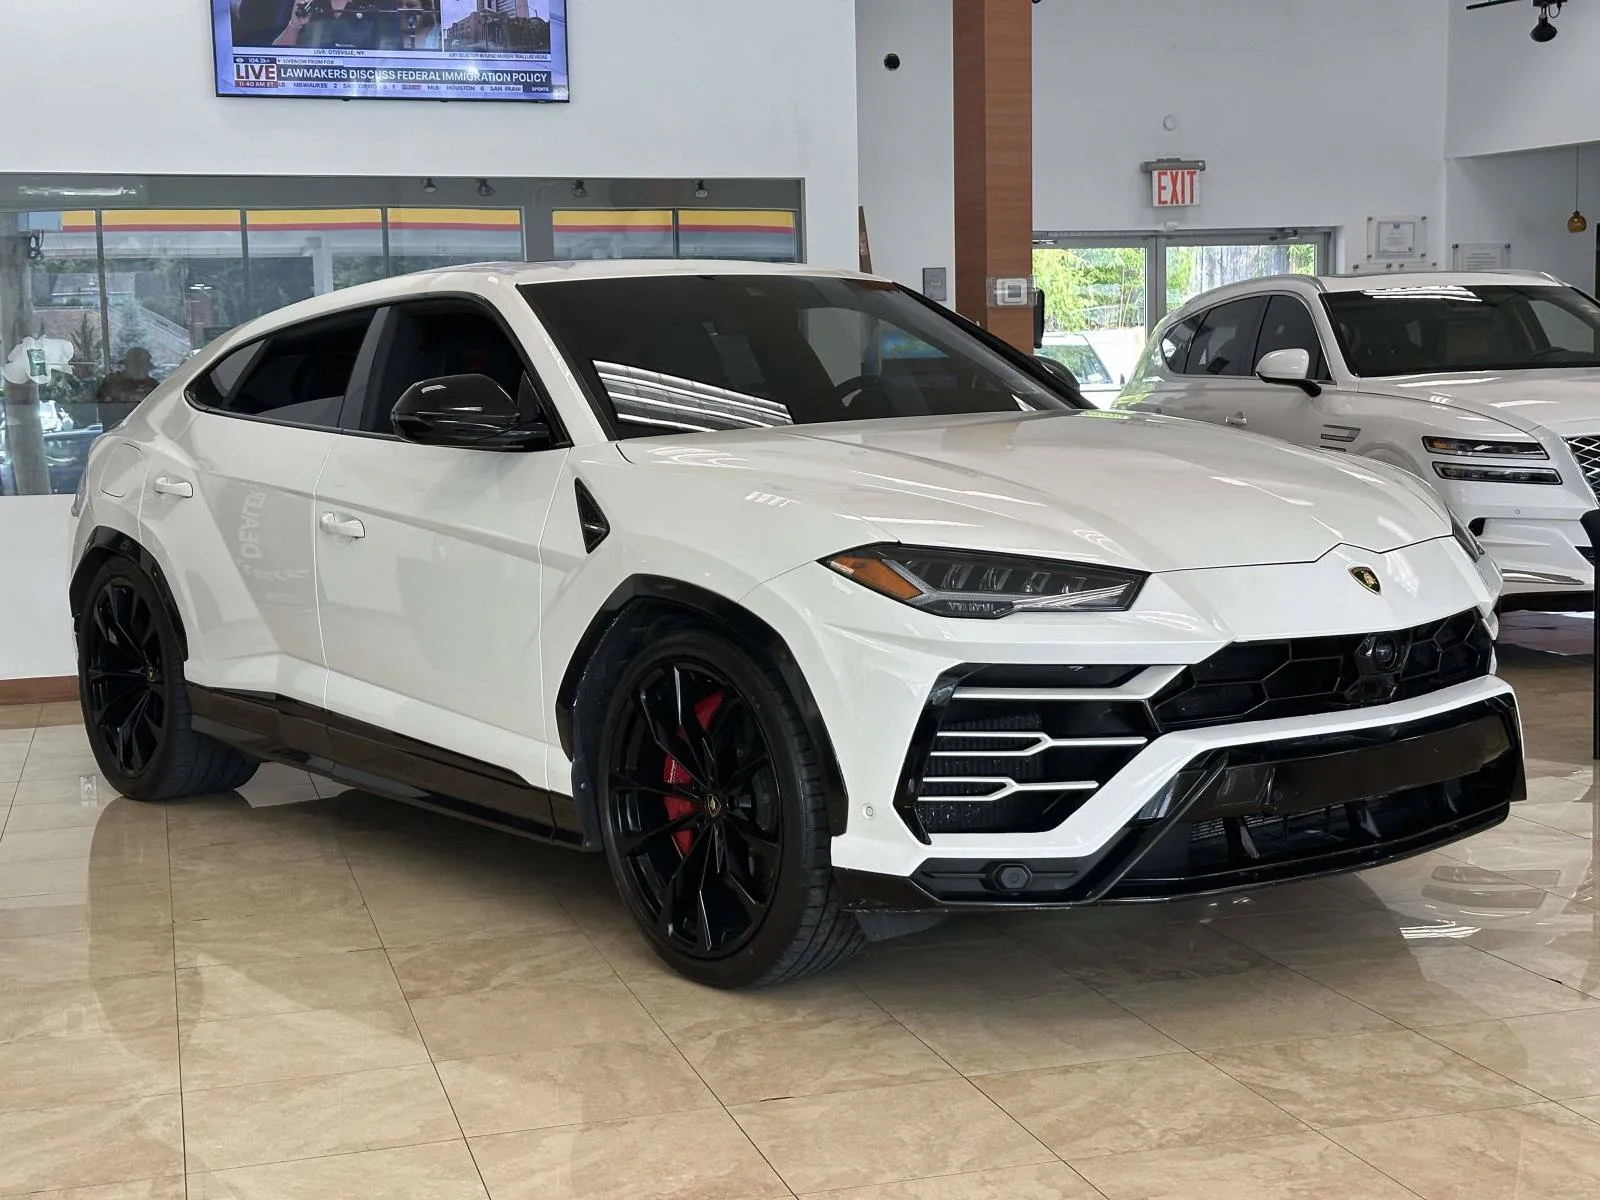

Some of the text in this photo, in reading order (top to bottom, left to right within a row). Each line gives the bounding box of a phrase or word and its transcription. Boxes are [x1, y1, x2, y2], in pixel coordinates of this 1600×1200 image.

[235, 64, 276, 80] LIVE
[281, 68, 547, 83] LAWMAKERS DISCUSS FEDERAL IMMIGRATION POLICY
[1157, 170, 1197, 205] EXIT
